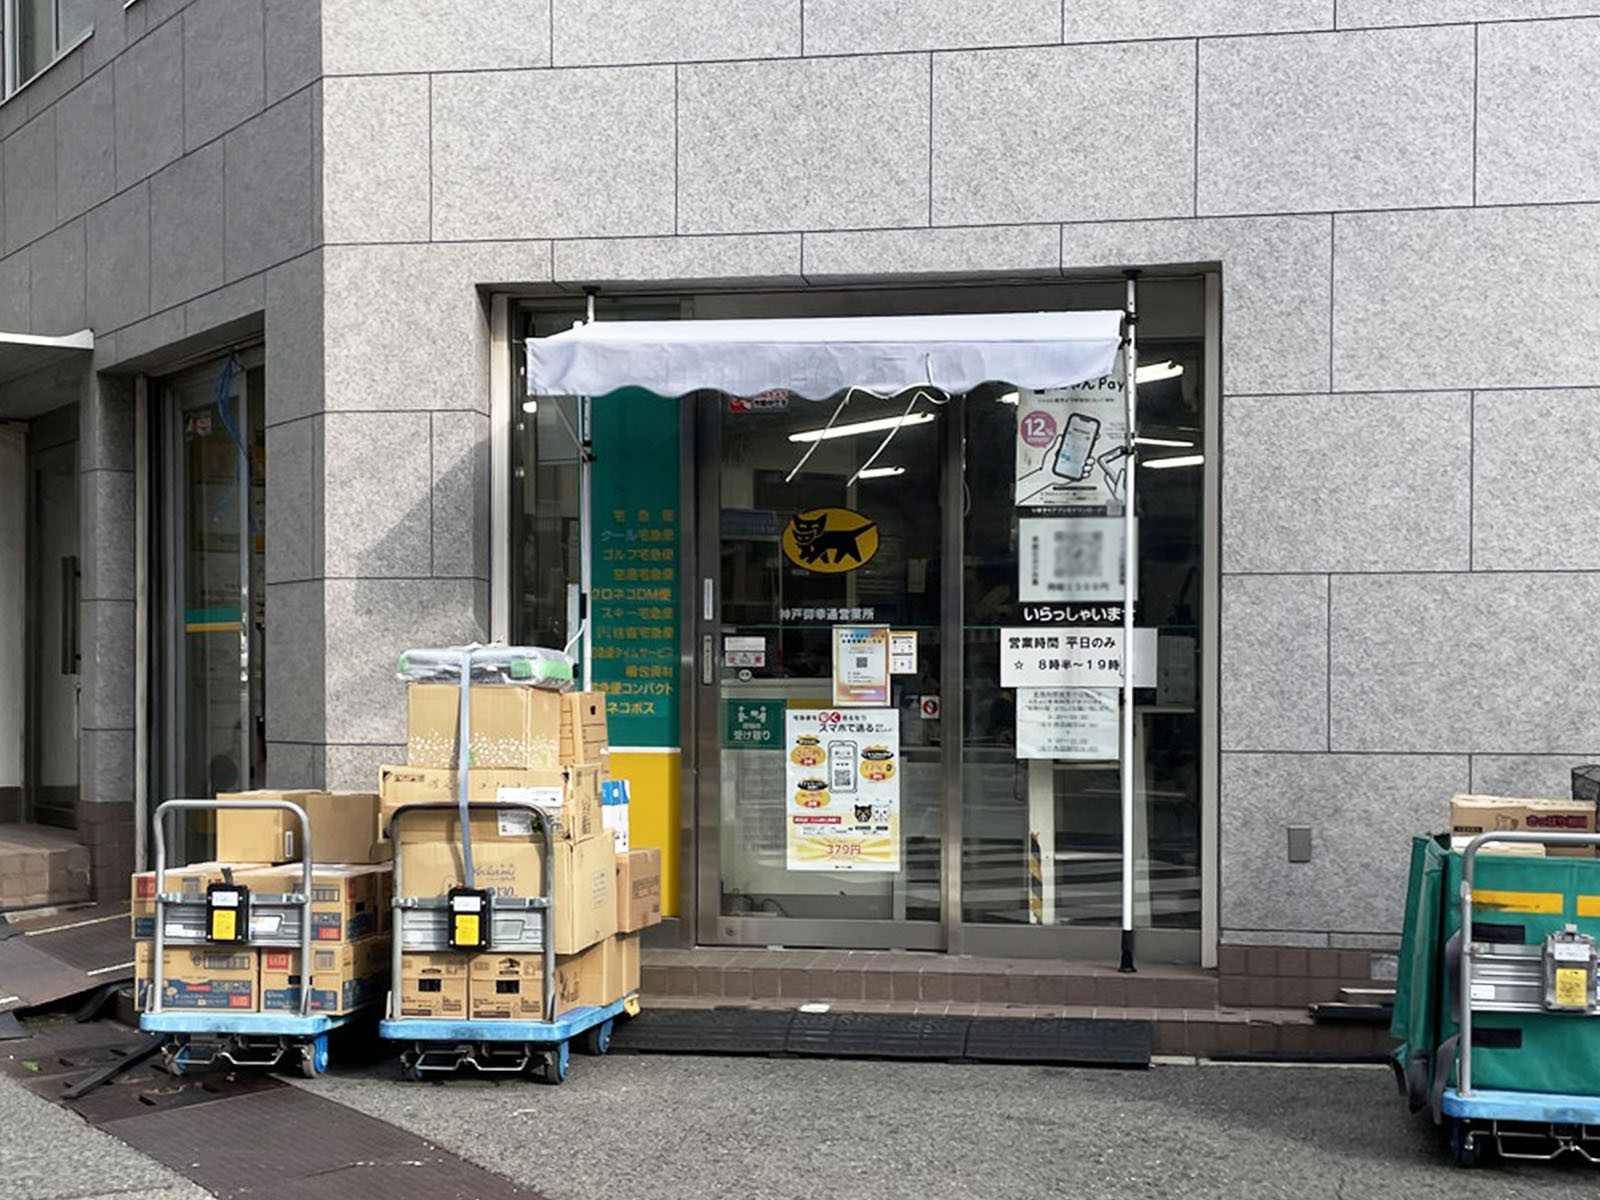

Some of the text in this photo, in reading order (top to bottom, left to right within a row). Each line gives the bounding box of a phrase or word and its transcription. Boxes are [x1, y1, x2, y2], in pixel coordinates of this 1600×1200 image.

[604, 548, 674, 560] ゴルフ宅急便
[1008, 636, 1116, 649] 営業時間 平日のみ
[607, 702, 656, 714] ネコポス
[827, 844, 862, 855] 379円
